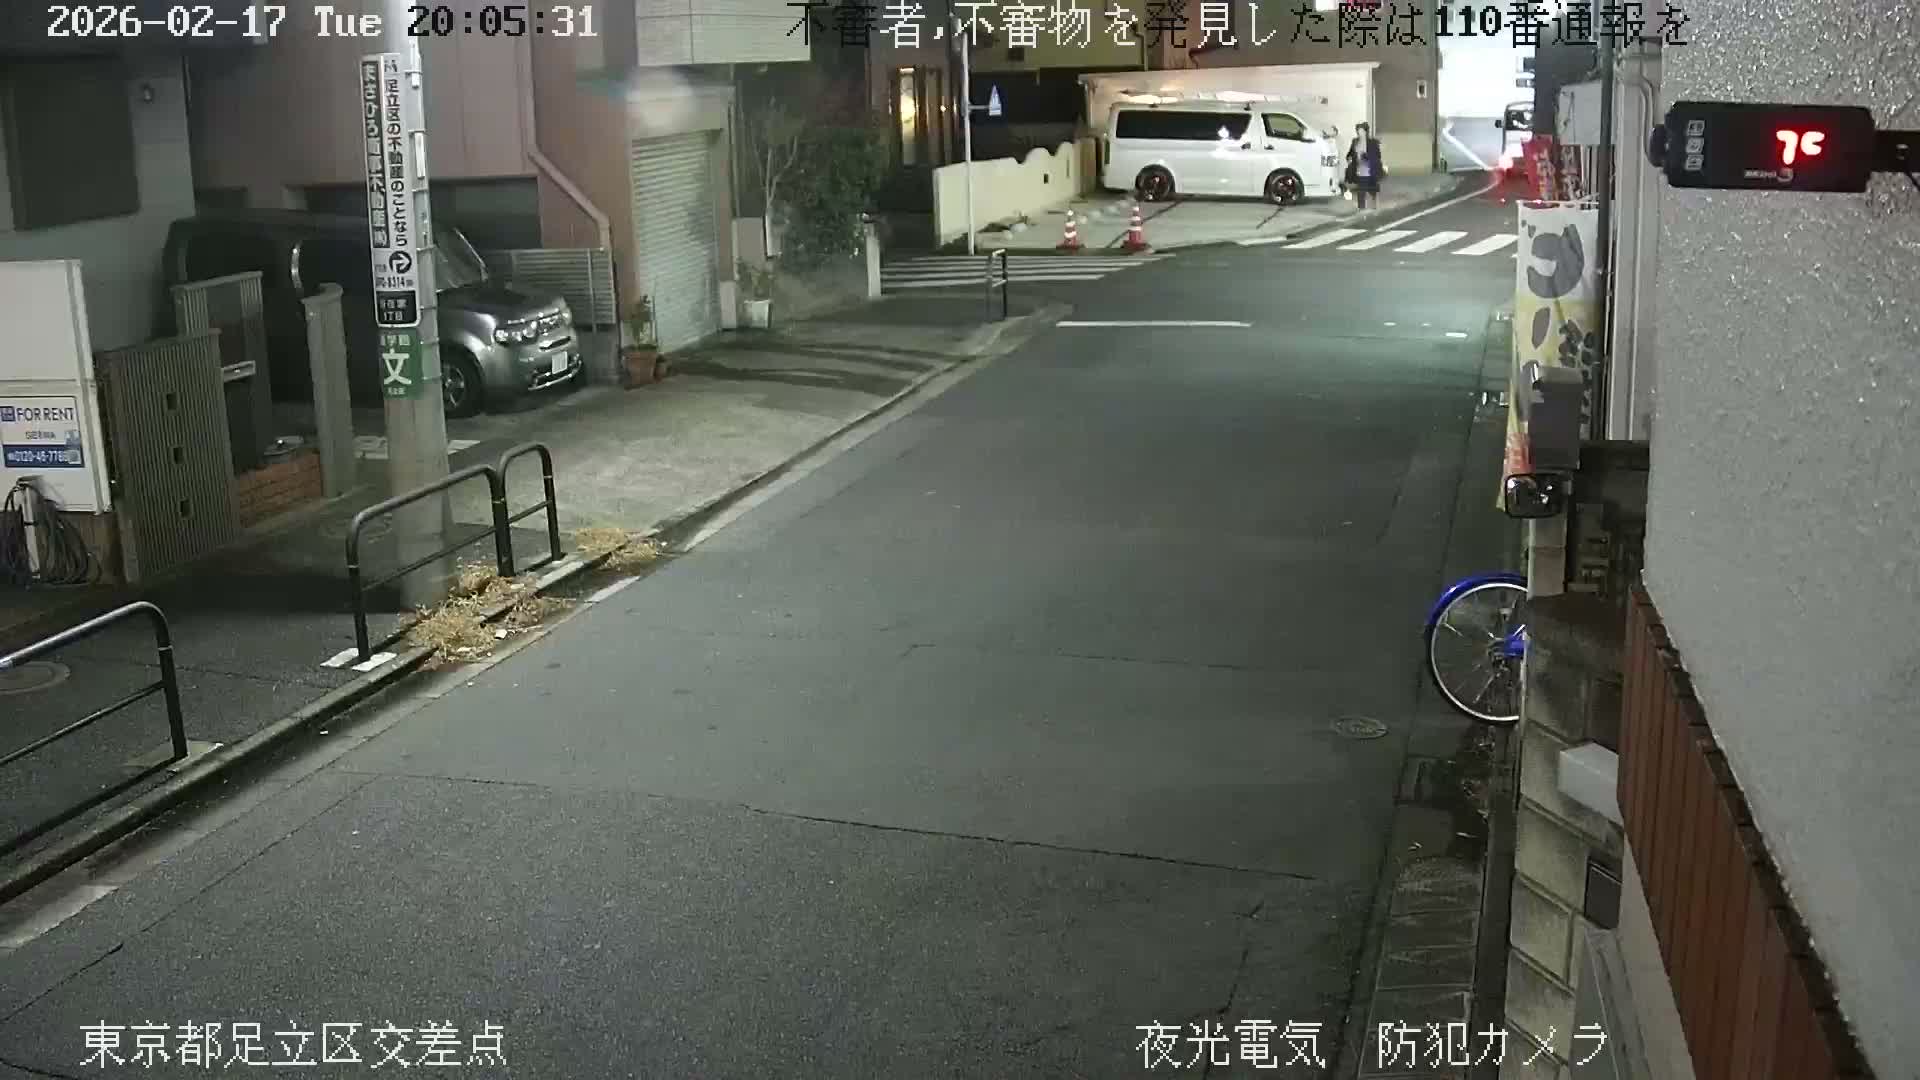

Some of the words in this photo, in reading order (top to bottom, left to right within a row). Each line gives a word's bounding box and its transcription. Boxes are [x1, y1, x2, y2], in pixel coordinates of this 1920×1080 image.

[382, 348, 412, 385] 文
[16, 407, 41, 421] FOR
[43, 407, 74, 421] RENT
